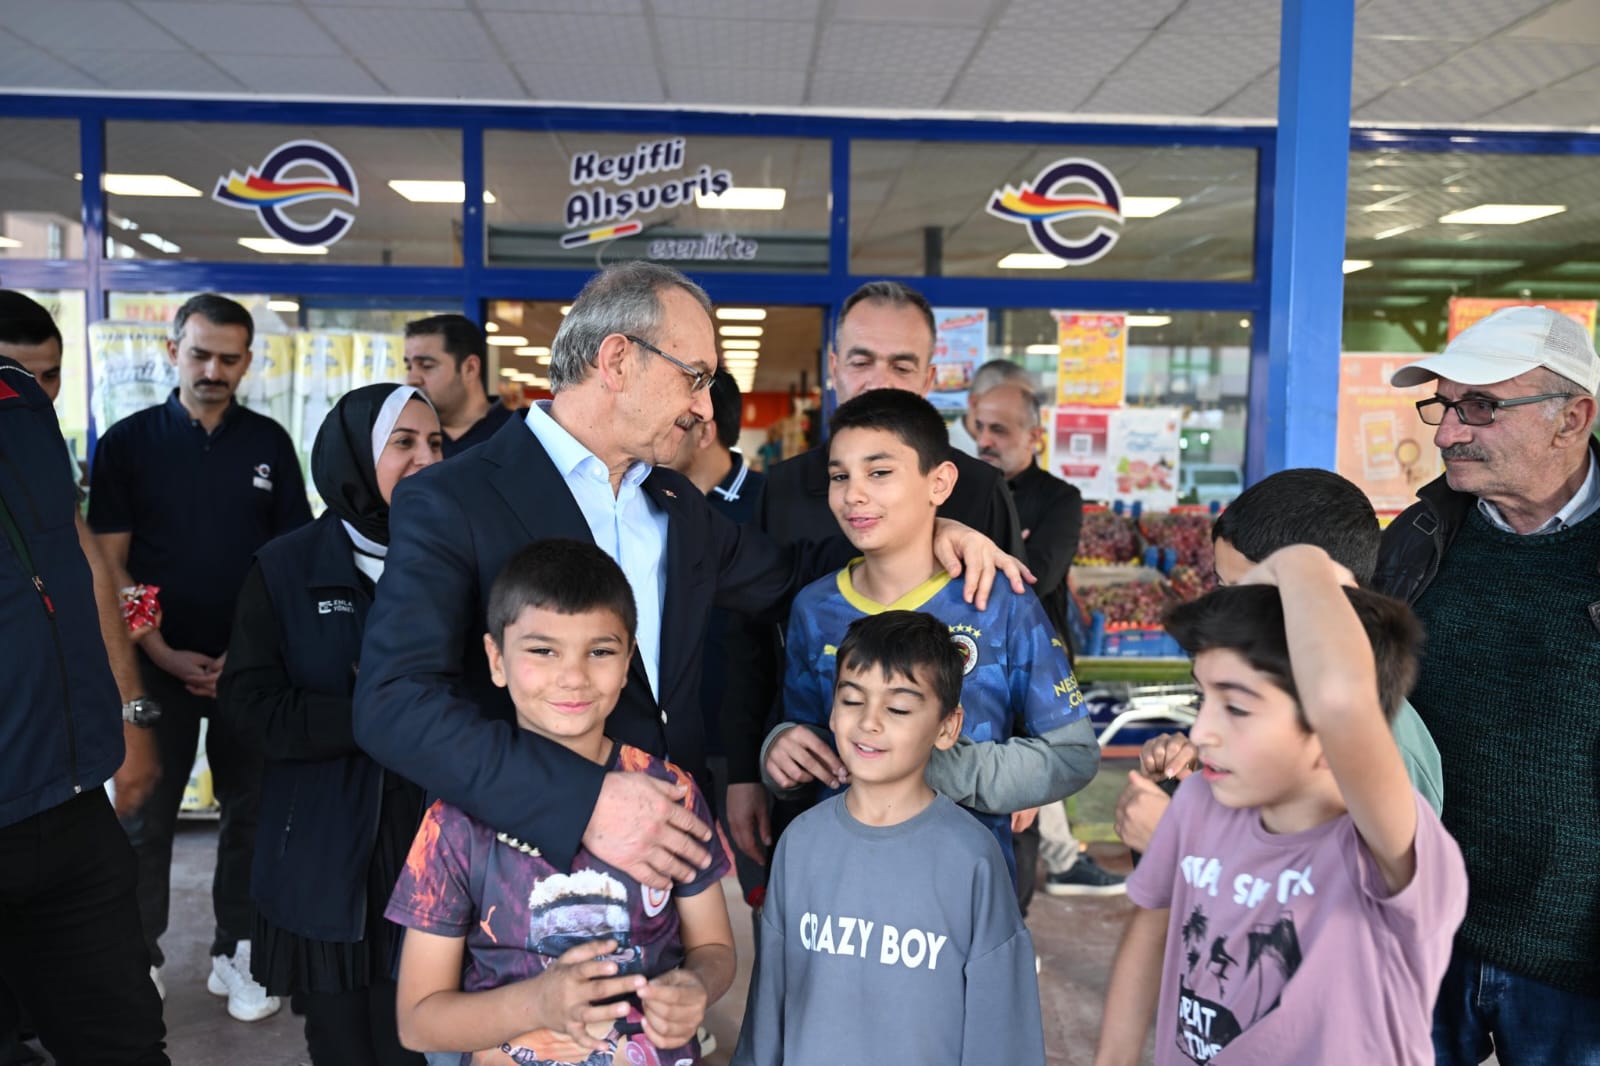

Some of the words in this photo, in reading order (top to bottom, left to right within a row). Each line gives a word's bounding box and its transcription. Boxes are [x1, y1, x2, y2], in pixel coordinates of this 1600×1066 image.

[571, 137, 686, 186] Keyifli
[564, 167, 731, 228] Alışveriş
[799, 911, 875, 959] CRAZY
[879, 924, 948, 971] BOY
